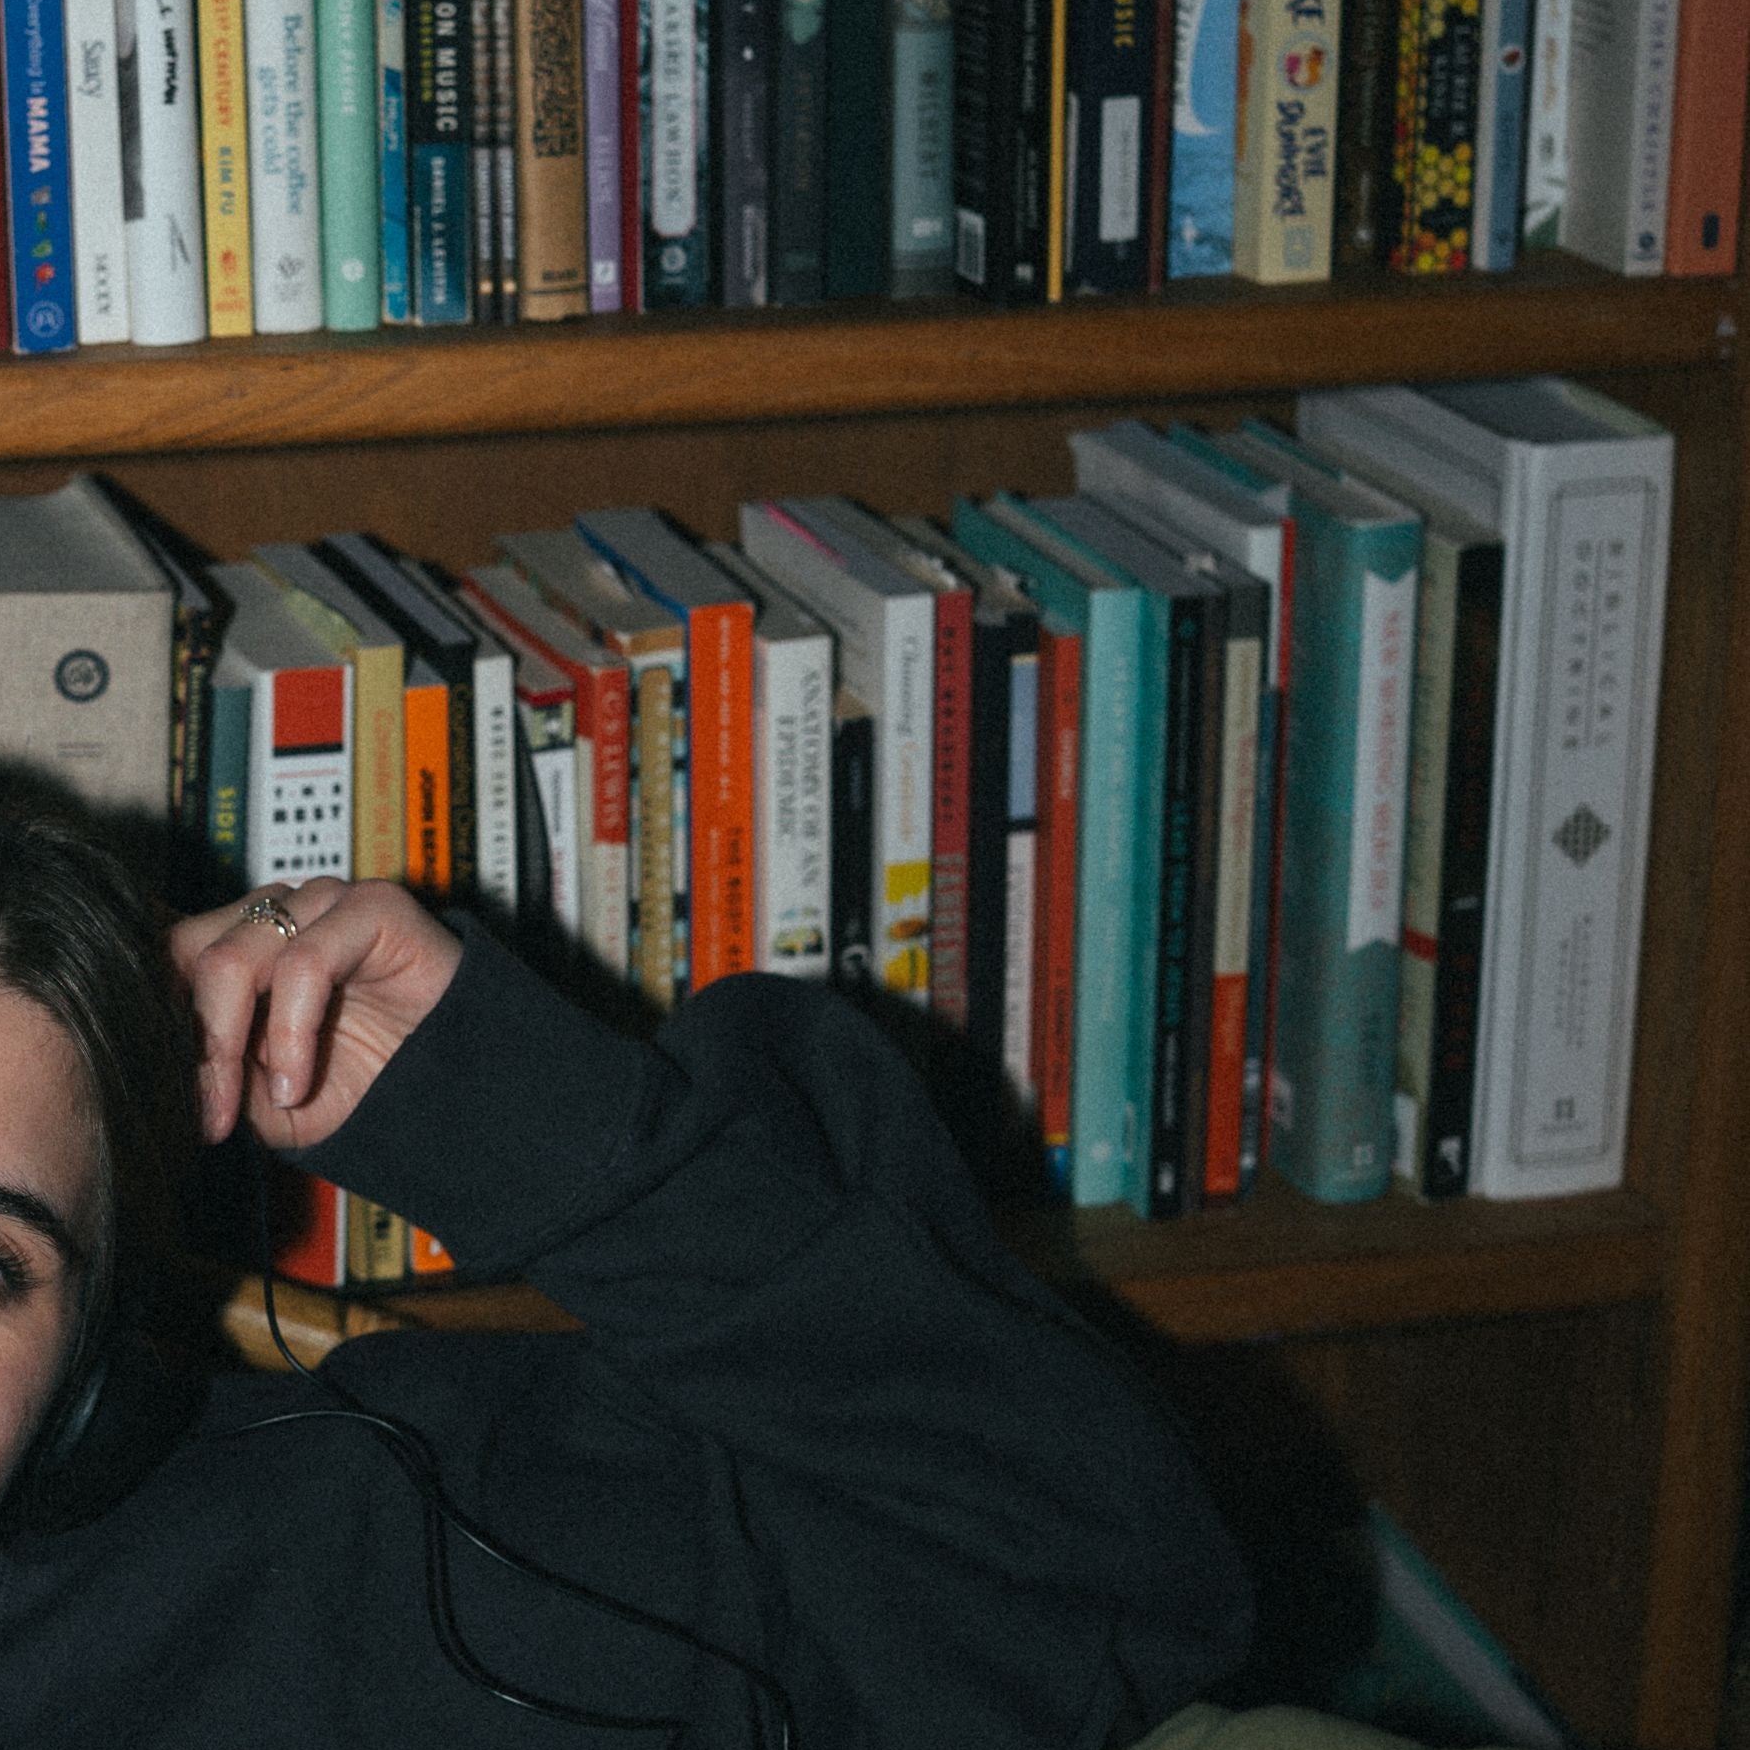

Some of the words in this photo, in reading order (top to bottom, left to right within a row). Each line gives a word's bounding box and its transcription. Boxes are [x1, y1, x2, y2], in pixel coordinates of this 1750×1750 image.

[282, 14, 304, 94] Before
[434, 2, 456, 37] ON
[212, 37, 234, 128] CENTURY
[434, 50, 458, 132] MUSIC
[26, 96, 50, 174] MAMA
[284, 101, 306, 141] the
[216, 146, 234, 184] KIM
[286, 146, 308, 216] coffee
[430, 156, 446, 218] DANIEL
[431, 238, 448, 305] LEVITIN
[1594, 538, 1626, 748] BIBLICAL
[800, 666, 822, 798] ANATOMY
[775, 715, 798, 842] EPIDEMIC
[801, 804, 822, 839] OF
[801, 848, 822, 888] AN
